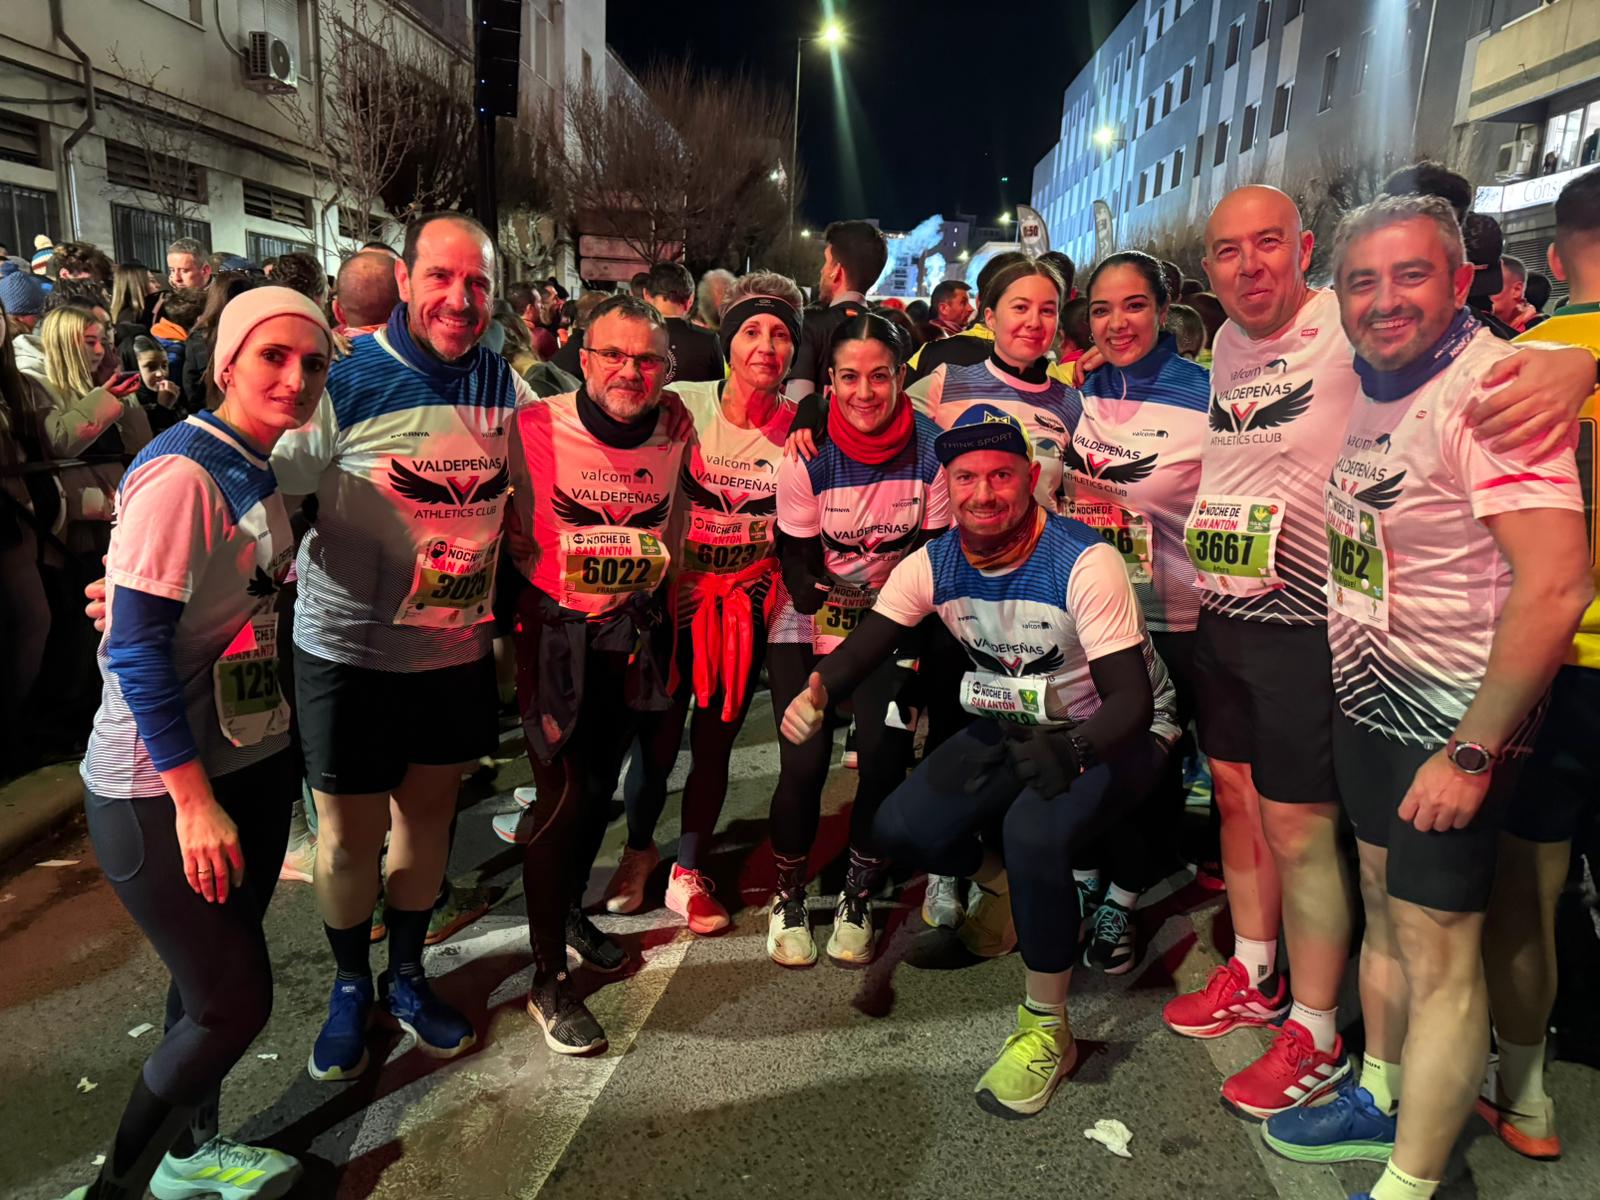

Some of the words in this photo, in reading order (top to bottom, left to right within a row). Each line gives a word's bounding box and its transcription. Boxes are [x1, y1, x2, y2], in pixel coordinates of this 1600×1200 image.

[1219, 382, 1293, 402] VALDEPEÑAS
[942, 440, 975, 450] THINK
[977, 432, 1013, 448] SPORT
[1074, 433, 1142, 461] VALDEPEÑAS
[1210, 433, 1251, 447] ATHLETICS
[1252, 432, 1283, 444] CLUB
[412, 456, 502, 473] VALDEPEÑAS
[706, 454, 752, 471] valcom
[1336, 458, 1388, 482] ALDEPEÑAS
[581, 468, 632, 484] valcom
[694, 469, 778, 494] VALDEPEÑAS
[1064, 470, 1103, 491] ATHLETICS
[1104, 484, 1128, 498] CLUB
[571, 487, 661, 504] VALDEPEÑAS
[413, 508, 474, 519] ATHLETICS
[475, 505, 497, 516] CLUB
[1076, 505, 1099, 515] NOCHE
[1101, 505, 1113, 514] DE
[1205, 506, 1228, 517] NOCHE
[1229, 507, 1241, 518] DE
[704, 523, 732, 534] NOCHE
[732, 524, 742, 533] DE
[833, 521, 910, 540] VALDEPEÑAS
[1193, 518, 1208, 529] SAN
[1208, 516, 1238, 531] ANTÓN
[586, 533, 618, 545] NOCHE
[620, 534, 632, 544] DE
[447, 549, 481, 562] NOCH
[574, 546, 597, 556] SAN
[598, 543, 633, 556] ANTÓN
[698, 543, 757, 568] 6023
[1196, 531, 1256, 566] 3667
[431, 559, 456, 573] SAN
[582, 556, 652, 586] 6022
[826, 605, 866, 630] 35
[973, 637, 1045, 656] VADEPEÑAS
[980, 686, 1002, 699] NOCHE
[1002, 690, 1013, 700] DE
[971, 696, 986, 708] SAN
[988, 698, 1016, 711] ANTÓN
